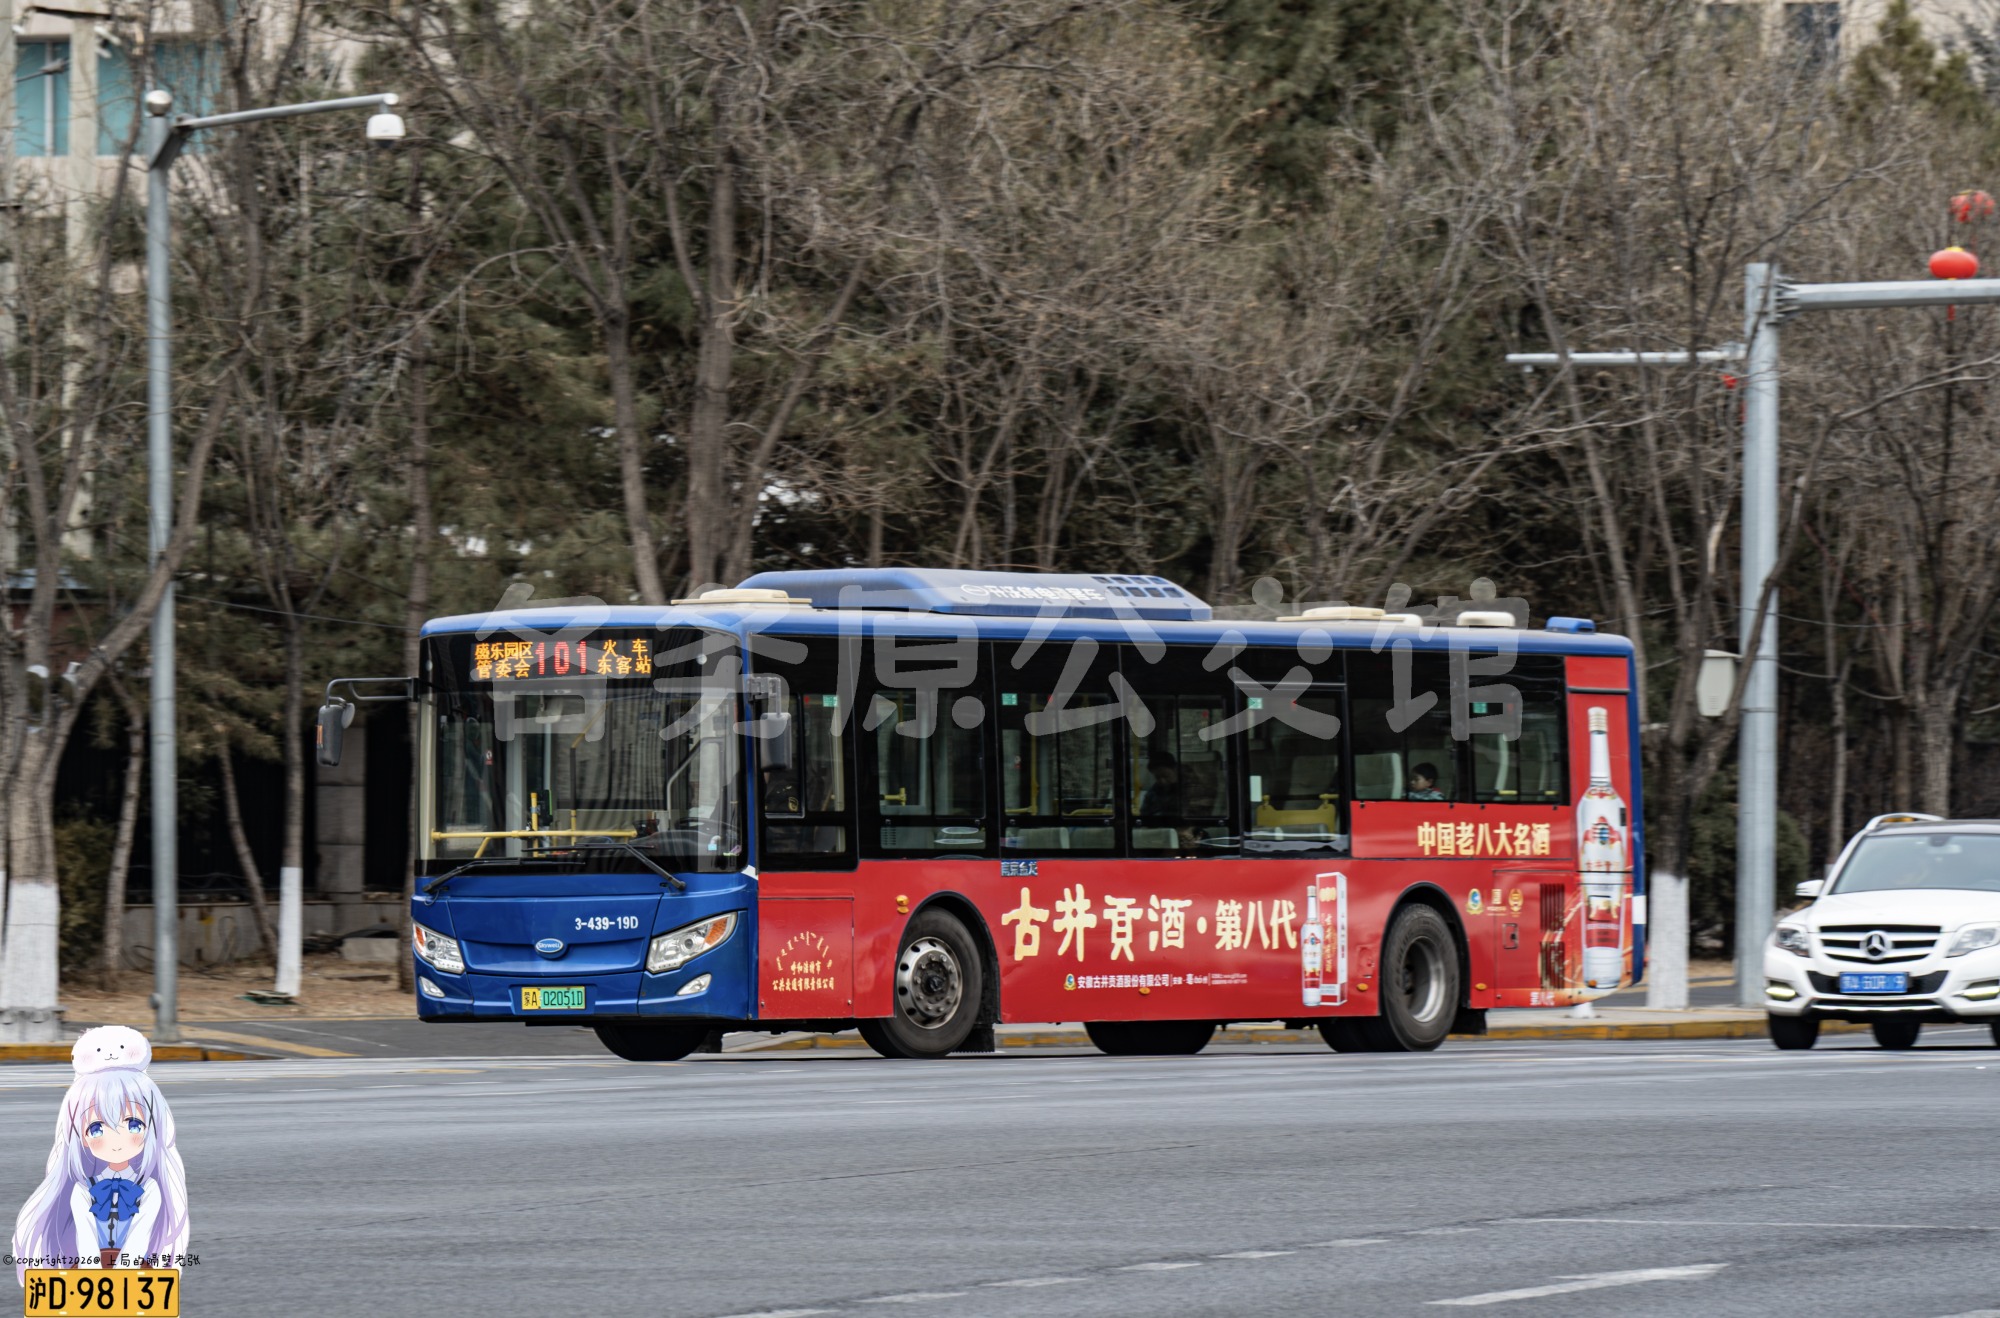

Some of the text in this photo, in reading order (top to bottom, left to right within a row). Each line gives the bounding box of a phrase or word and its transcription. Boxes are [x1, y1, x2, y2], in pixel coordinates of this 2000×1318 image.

[474, 641, 534, 661] 盛乐园区
[535, 641, 587, 675] 101
[603, 638, 648, 658] 火车
[475, 658, 531, 679] 管委会
[597, 656, 652, 676] 东客站
[1417, 821, 1551, 856] 中国老八大名酒
[574, 916, 639, 931] 3-439-19D
[1077, 973, 1170, 989] 安徽古井贡酒股份有限公司
